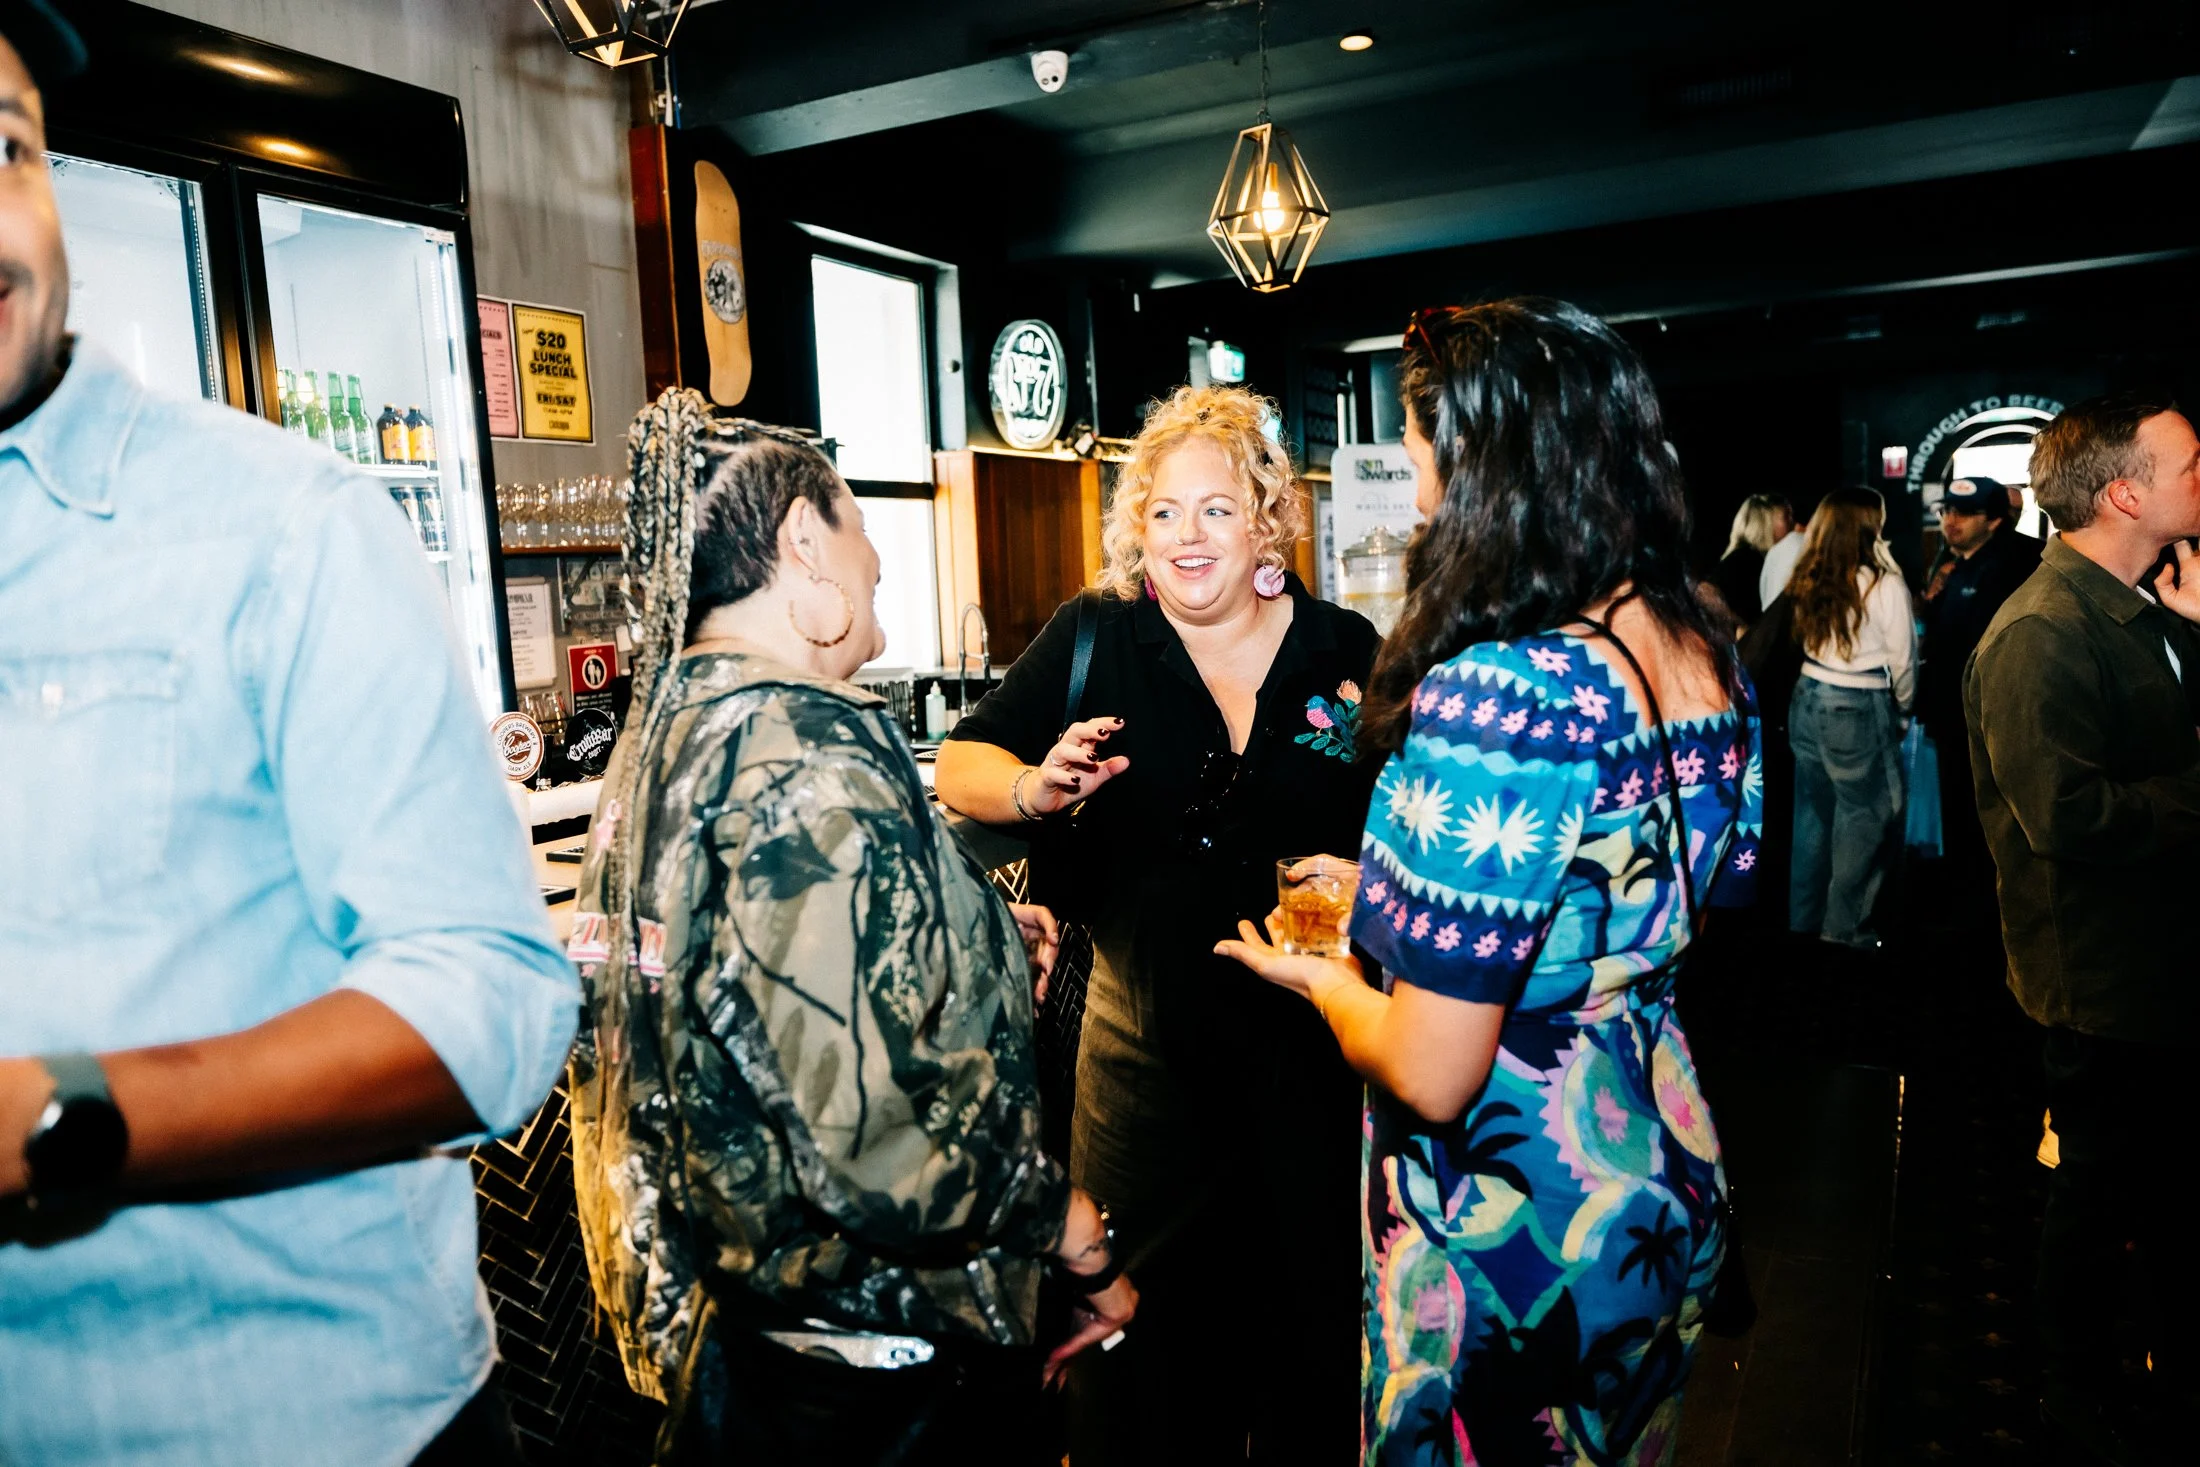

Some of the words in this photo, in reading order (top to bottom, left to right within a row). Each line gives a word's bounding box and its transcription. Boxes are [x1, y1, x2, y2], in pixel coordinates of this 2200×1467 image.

[537, 330, 567, 350] $20
[534, 351, 571, 365] LUNCH
[530, 363, 577, 379] SPECIAL
[1906, 408, 1968, 494] THROUGH
[1970, 396, 2001, 413] TO
[497, 723, 515, 746] COOPERS
[516, 722, 537, 740] BREWERY
[507, 764, 521, 772] DARK
[523, 761, 532, 771] ALE
